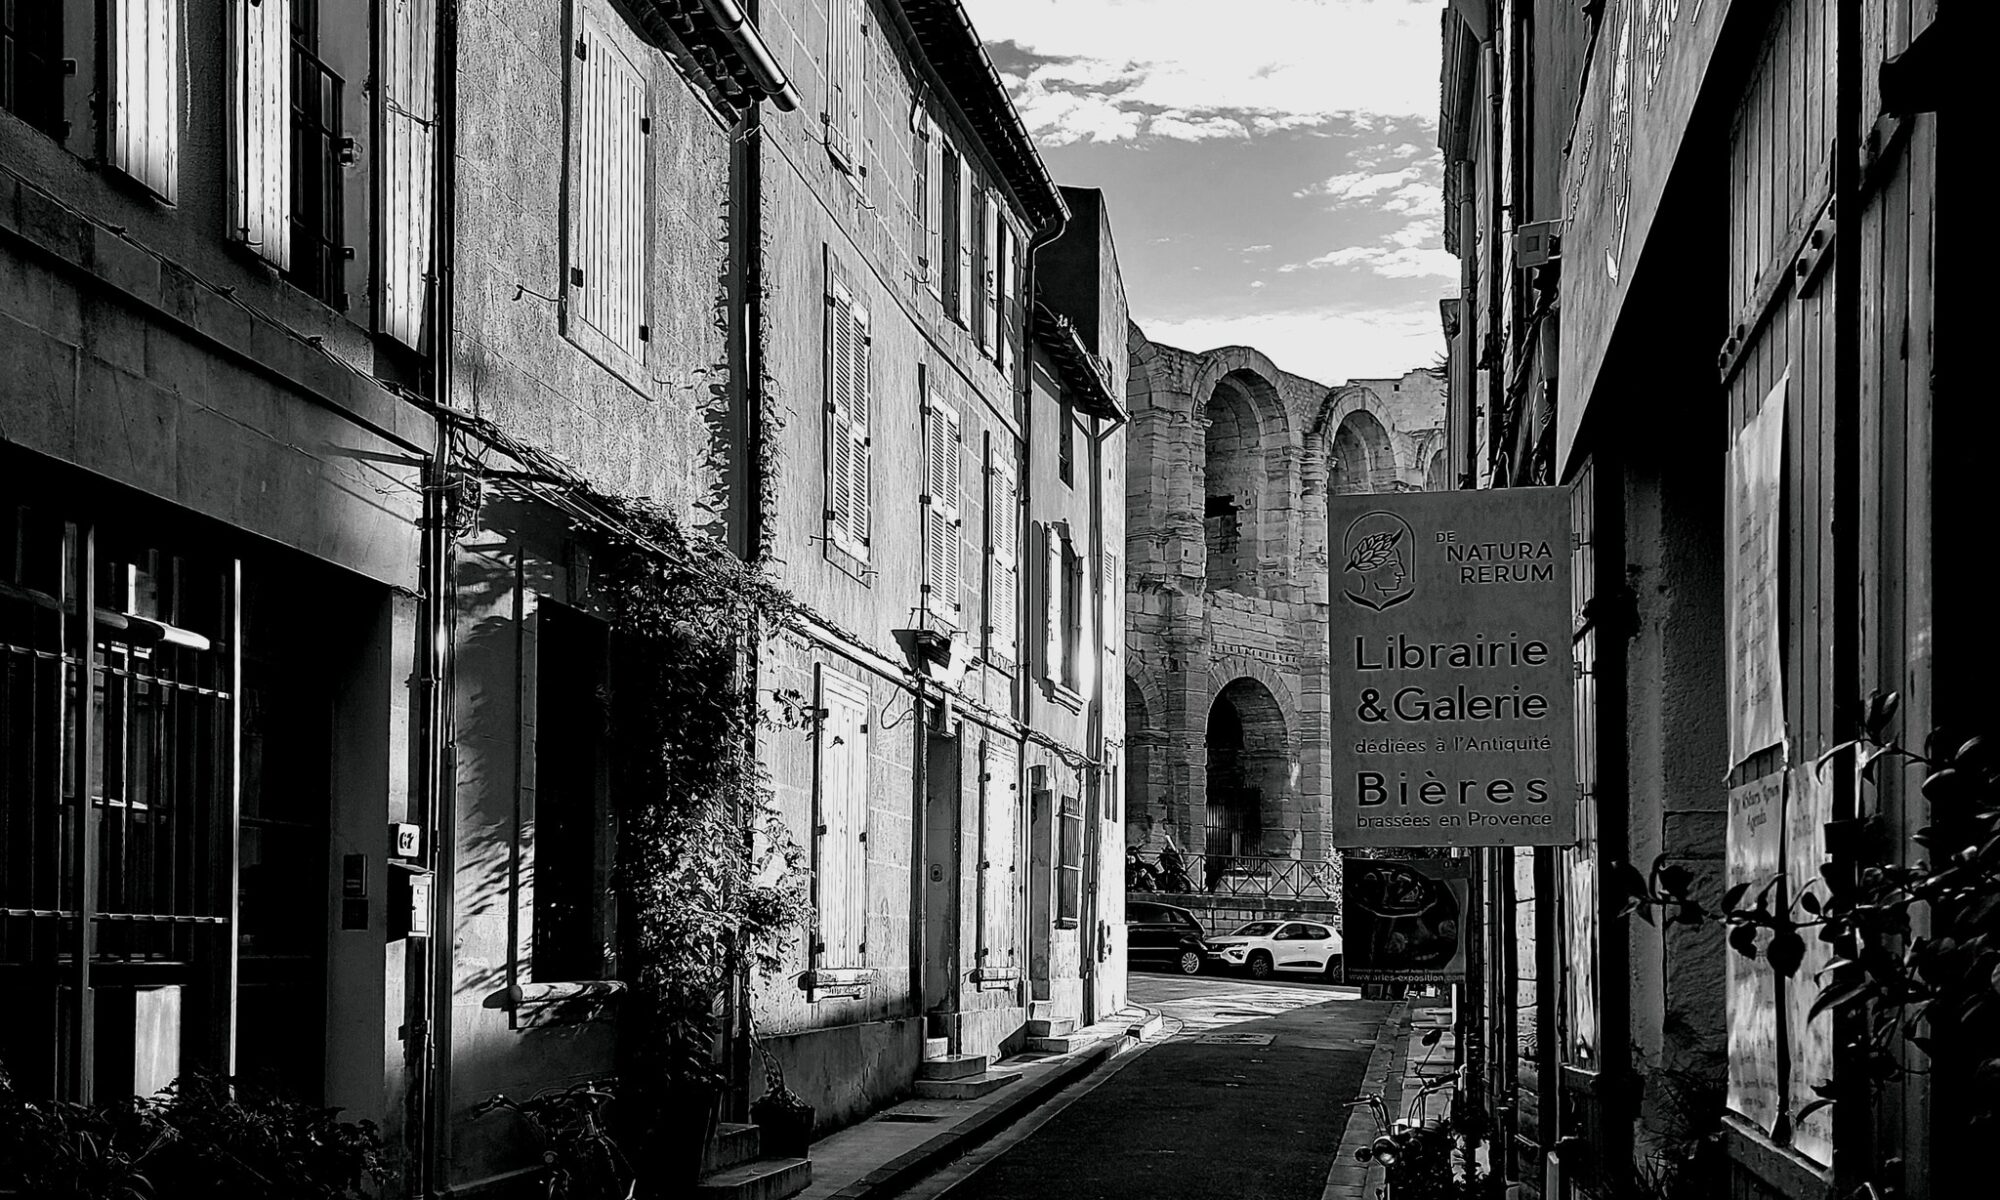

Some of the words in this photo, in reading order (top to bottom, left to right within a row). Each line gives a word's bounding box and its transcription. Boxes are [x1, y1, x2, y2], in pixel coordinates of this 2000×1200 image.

[1436, 531, 1455, 543] DE
[1447, 542, 1553, 562] NATURA
[1462, 564, 1552, 583] RERUM
[1357, 633, 1547, 669] Librairie
[1356, 739, 1425, 753] dédiées
[1436, 738, 1445, 751] à
[1455, 735, 1550, 752] l'Antiquité
[1358, 771, 1547, 805] Bières
[1358, 813, 1430, 827] brassées
[1440, 816, 1460, 826] en
[1469, 812, 1551, 825] Provence
